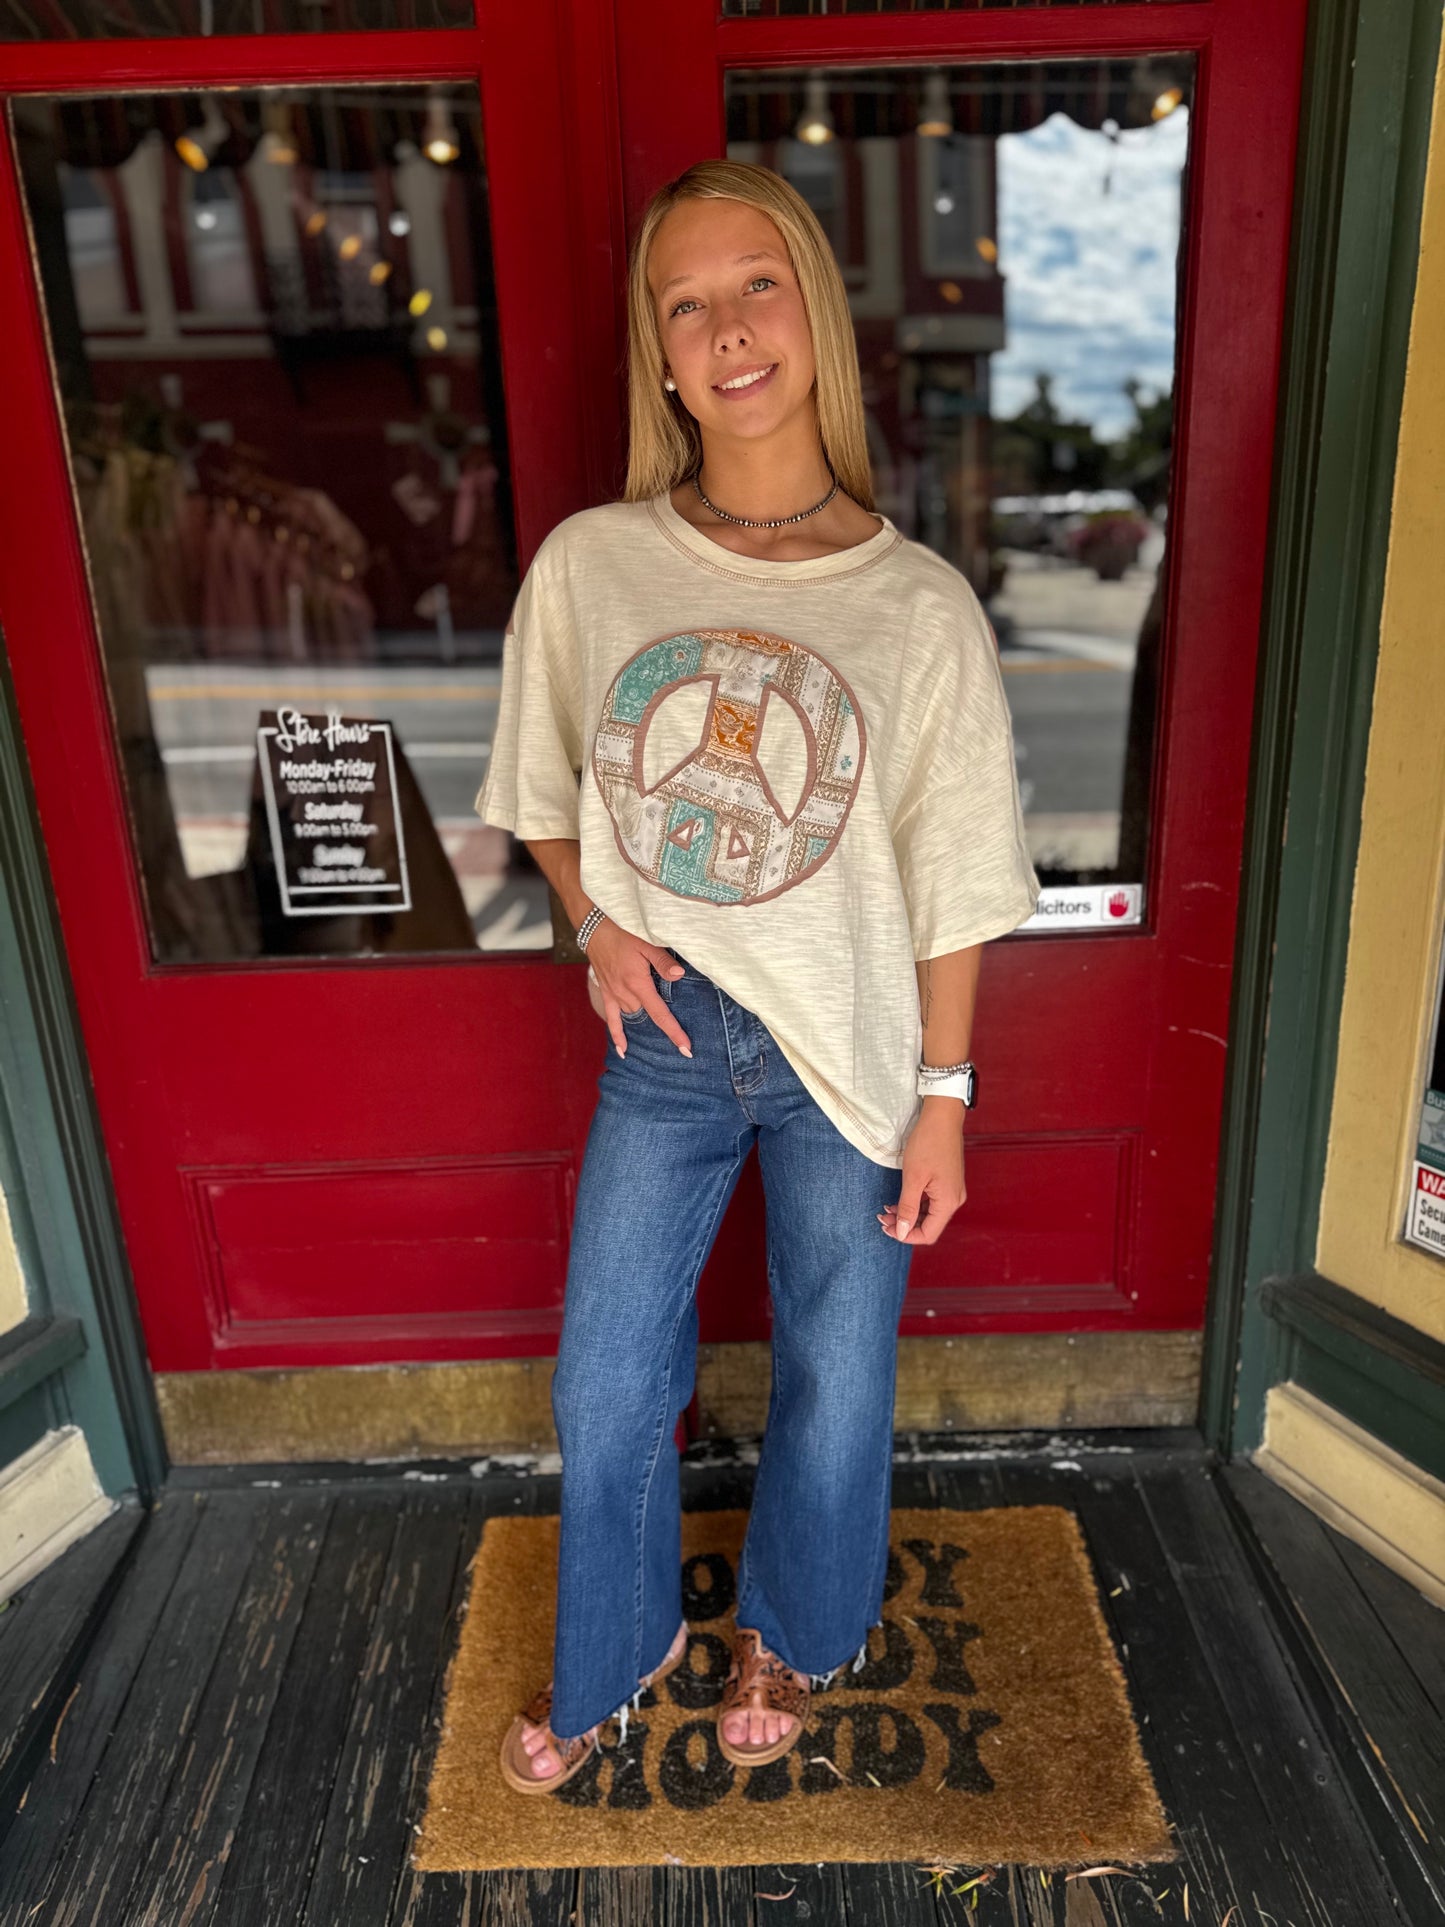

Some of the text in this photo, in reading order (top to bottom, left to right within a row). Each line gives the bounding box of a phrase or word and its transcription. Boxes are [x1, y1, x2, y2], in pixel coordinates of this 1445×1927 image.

[275, 702, 370, 752] Store Hours
[280, 758, 376, 781] Monday-Friday
